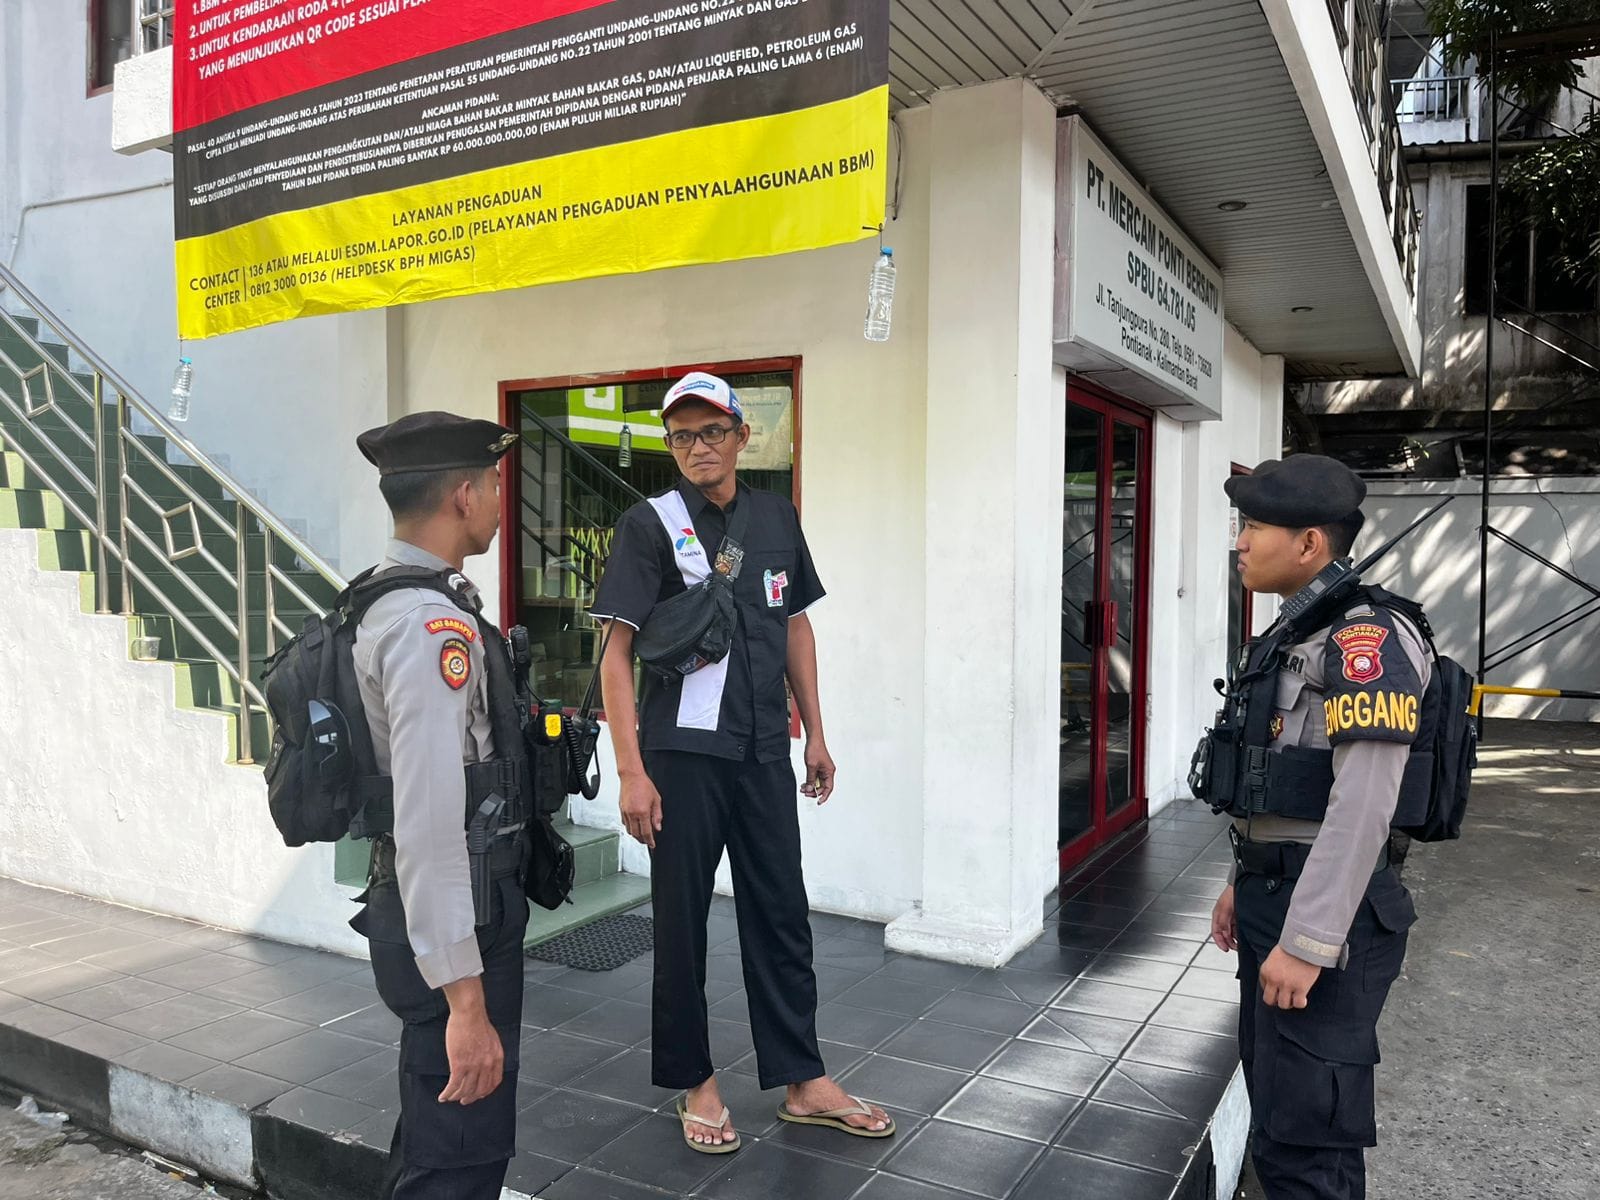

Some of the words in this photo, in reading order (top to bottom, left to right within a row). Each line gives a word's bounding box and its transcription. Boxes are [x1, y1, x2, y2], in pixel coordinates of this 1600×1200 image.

[199, 33, 229, 58] UNTUK
[233, 10, 294, 44] KENDARAAN
[298, 0, 328, 21] RODA
[199, 59, 224, 79] YANG
[227, 30, 304, 70] MENUNJUKKAN
[307, 23, 322, 44] QR
[325, 12, 355, 36] CODE
[359, 0, 399, 25] SESUAI
[200, 10, 230, 36] UNTUK
[188, 141, 206, 154] PASAL
[208, 138, 214, 147] 40
[216, 131, 235, 144] ANGKA
[242, 110, 298, 137] UNDANG-UNDANG
[300, 105, 317, 119] NO.6
[319, 98, 342, 113] TAHUN
[344, 92, 363, 106] 2023
[365, 82, 398, 100] TENTANG
[400, 69, 444, 91] PENETAPAN
[446, 55, 493, 78] PERATURAN
[496, 41, 549, 65] PEMERINTAH
[552, 27, 604, 49] PENGGANTI
[607, 2, 698, 36] UNDANG-UNDANG
[206, 147, 221, 159] CIPTA
[223, 141, 239, 154] KERJA
[240, 131, 265, 147] MENJADI
[267, 114, 327, 140] UNDANG-UNDANG
[329, 109, 347, 123] ATAS
[349, 96, 392, 117] PERUBAHAN
[394, 84, 438, 105] KETENTUAN
[440, 77, 465, 93] PASAL
[468, 73, 477, 85] 55
[479, 53, 558, 82] UNDANG-UNDANG
[561, 44, 590, 62] NO.22
[593, 35, 625, 53] TAHUN
[628, 29, 651, 45] 2001
[654, 16, 701, 39] TENTANG
[704, 5, 744, 26] MINYAK
[747, 0, 771, 14] DAN
[217, 174, 236, 187] ORANG
[237, 168, 252, 180] YANG
[254, 151, 322, 177] MENYALAHGUNAKAN
[324, 137, 381, 158] PENGANGKUTAN
[384, 125, 424, 149] DAN/ATAU
[426, 118, 451, 139] NIAGA
[454, 110, 482, 126] BAHAN
[485, 103, 513, 118] BAKAR
[516, 93, 550, 111] MINYAK
[553, 85, 584, 103] BAHAN
[587, 77, 619, 95] BAKAR
[622, 72, 645, 86] GAS,
[649, 58, 702, 81] DAN/ATAU
[767, 30, 830, 55] PETROLEUM
[834, 23, 856, 39] GAS
[422, 100, 463, 120] ANCAMAN
[465, 93, 499, 107] PIDANA:
[189, 194, 207, 207] YANG
[209, 186, 233, 201] DISUBSIDI
[235, 177, 263, 192] DAN/ATAU
[265, 166, 306, 184] PENYEDIAAN
[308, 163, 322, 176] DAN
[325, 142, 401, 170] PENDISTRIBUSIANNYA
[403, 132, 444, 151] DIBERIKAN
[446, 120, 496, 141] PENUGASAN
[499, 107, 552, 129] PEMERINTAH
[555, 95, 600, 116] DIPIDANA
[602, 87, 643, 105] DENGAN
[646, 78, 684, 96] PIDANA
[687, 67, 734, 87] PENJARA
[737, 57, 778, 78] PALING
[782, 50, 813, 68] LAMA
[816, 49, 822, 60] 6
[826, 38, 863, 57] (ENAM)
[282, 178, 305, 192] TAHUN
[307, 174, 321, 186] DAN
[323, 168, 349, 182] PIDANA
[351, 161, 376, 175] DENDA
[378, 155, 405, 169] PALING
[407, 147, 438, 163] BANYAK
[441, 144, 451, 155] RP
[540, 117, 569, 133] (ENAM
[572, 110, 602, 126] PULUH
[605, 102, 637, 120] MILIAR
[249, 263, 263, 278] 136
[265, 256, 288, 273] ATAU
[292, 246, 341, 268] MELALUI
[469, 208, 557, 237] (PELAYANAN
[563, 190, 659, 220] PENGADUAN
[665, 161, 833, 205] PENYALAHGUNAAN
[839, 149, 875, 175] BBM)
[393, 202, 452, 227] LAYANAN
[458, 185, 541, 214] PENGADUAN
[1087, 158, 1105, 212] PT.
[1109, 180, 1156, 258] MERCAM
[1158, 229, 1185, 284] PONTI
[1187, 258, 1219, 315] BERSATU
[190, 270, 239, 291] CONTACT
[205, 291, 240, 308] CENTER
[250, 281, 271, 297] 0812
[274, 274, 296, 291] 3000
[300, 269, 327, 285] 0136
[332, 257, 395, 282] (HELPDESK
[400, 254, 424, 270] BPH
[429, 245, 475, 266] MIGAS)
[1127, 250, 1155, 300] SPBU
[1157, 276, 1195, 332] 64.781.05
[1096, 282, 1105, 307] Jl.
[1107, 288, 1148, 335] Tanjungpura
[1121, 326, 1153, 363] Pontianak
[680, 549, 702, 558] TAMINA
